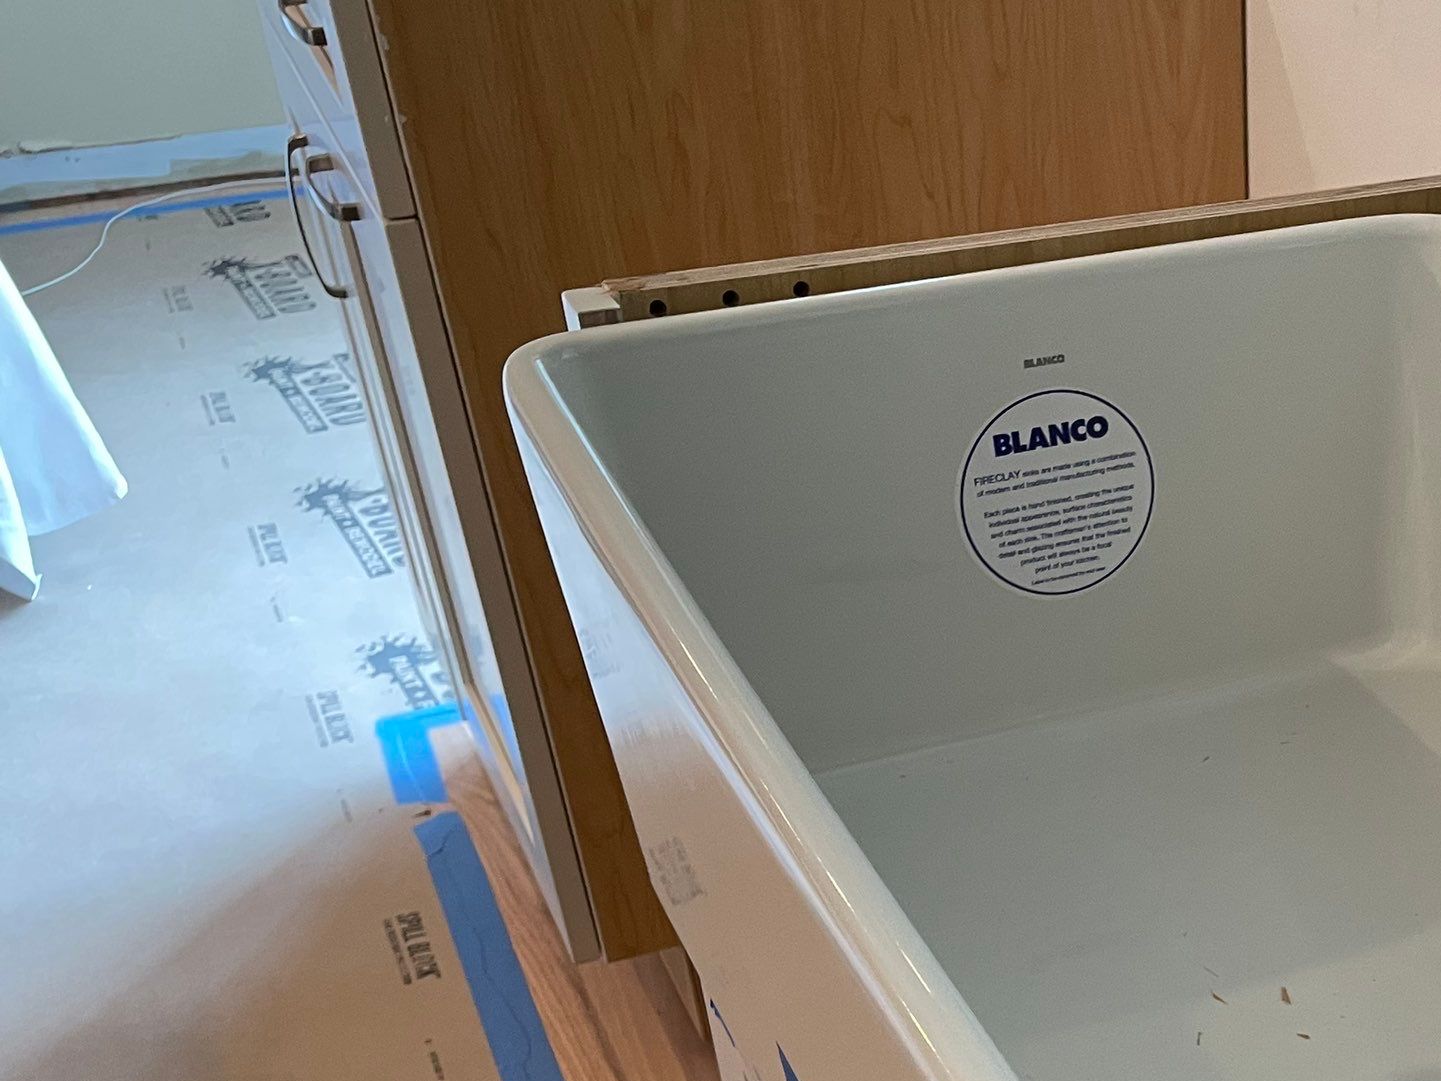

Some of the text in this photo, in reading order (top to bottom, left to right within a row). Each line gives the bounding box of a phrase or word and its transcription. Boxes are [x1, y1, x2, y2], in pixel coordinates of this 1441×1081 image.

[1023, 354, 1065, 369] BLANCO
[992, 415, 1109, 458] BLANCO
[974, 470, 1021, 487] FIRECLAY
